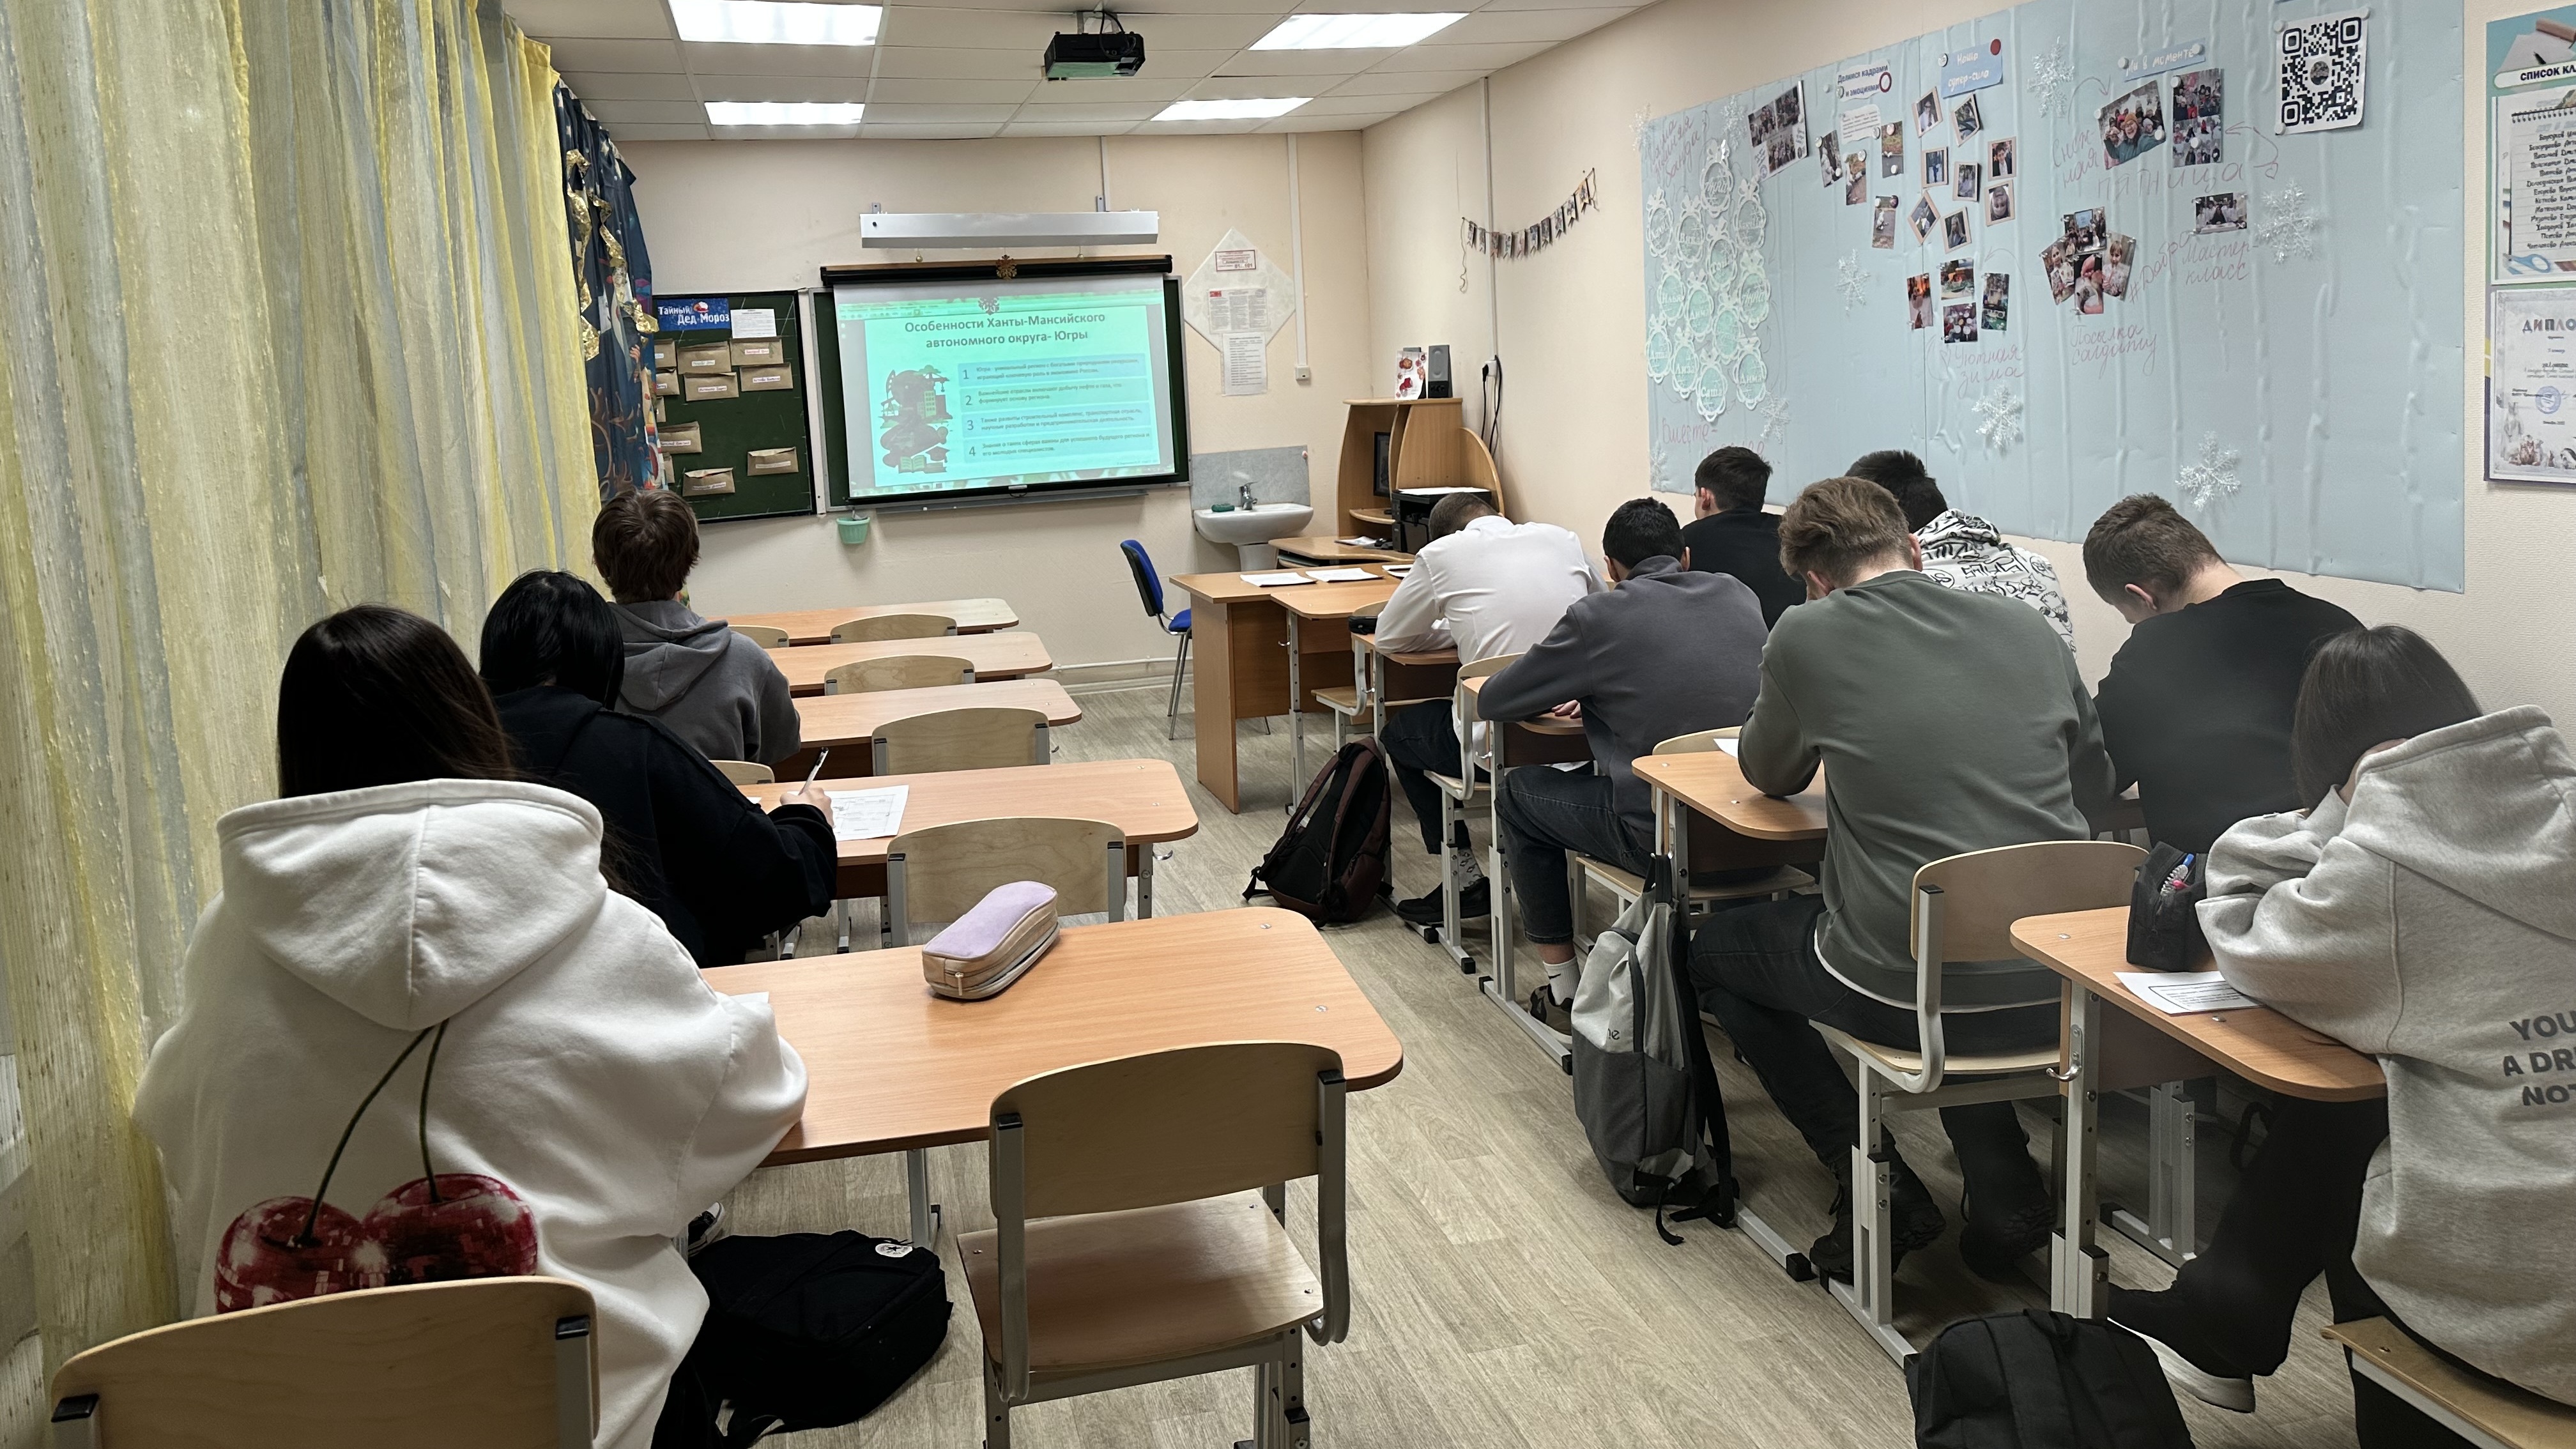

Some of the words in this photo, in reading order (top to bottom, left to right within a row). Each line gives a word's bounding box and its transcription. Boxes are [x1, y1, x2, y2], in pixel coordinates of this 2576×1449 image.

[2520, 66, 2560, 81] СПИСОК
[658, 306, 691, 315] Тайный
[678, 314, 697, 325] Дед
[700, 313, 730, 324] Мороз
[905, 319, 984, 332] Особенности
[987, 312, 1106, 328] Ханты-Мансийского
[2522, 318, 2576, 333] ДИПЛО
[926, 335, 1005, 348] автономного
[1055, 330, 1088, 344] Югры
[962, 369, 969, 380] 1
[965, 395, 972, 406] 2
[967, 419, 974, 430] 3
[969, 446, 976, 457] 4
[2508, 1010, 2576, 1041] YOU
[2503, 1055, 2524, 1077] A
[2529, 1046, 2576, 1073] DR
